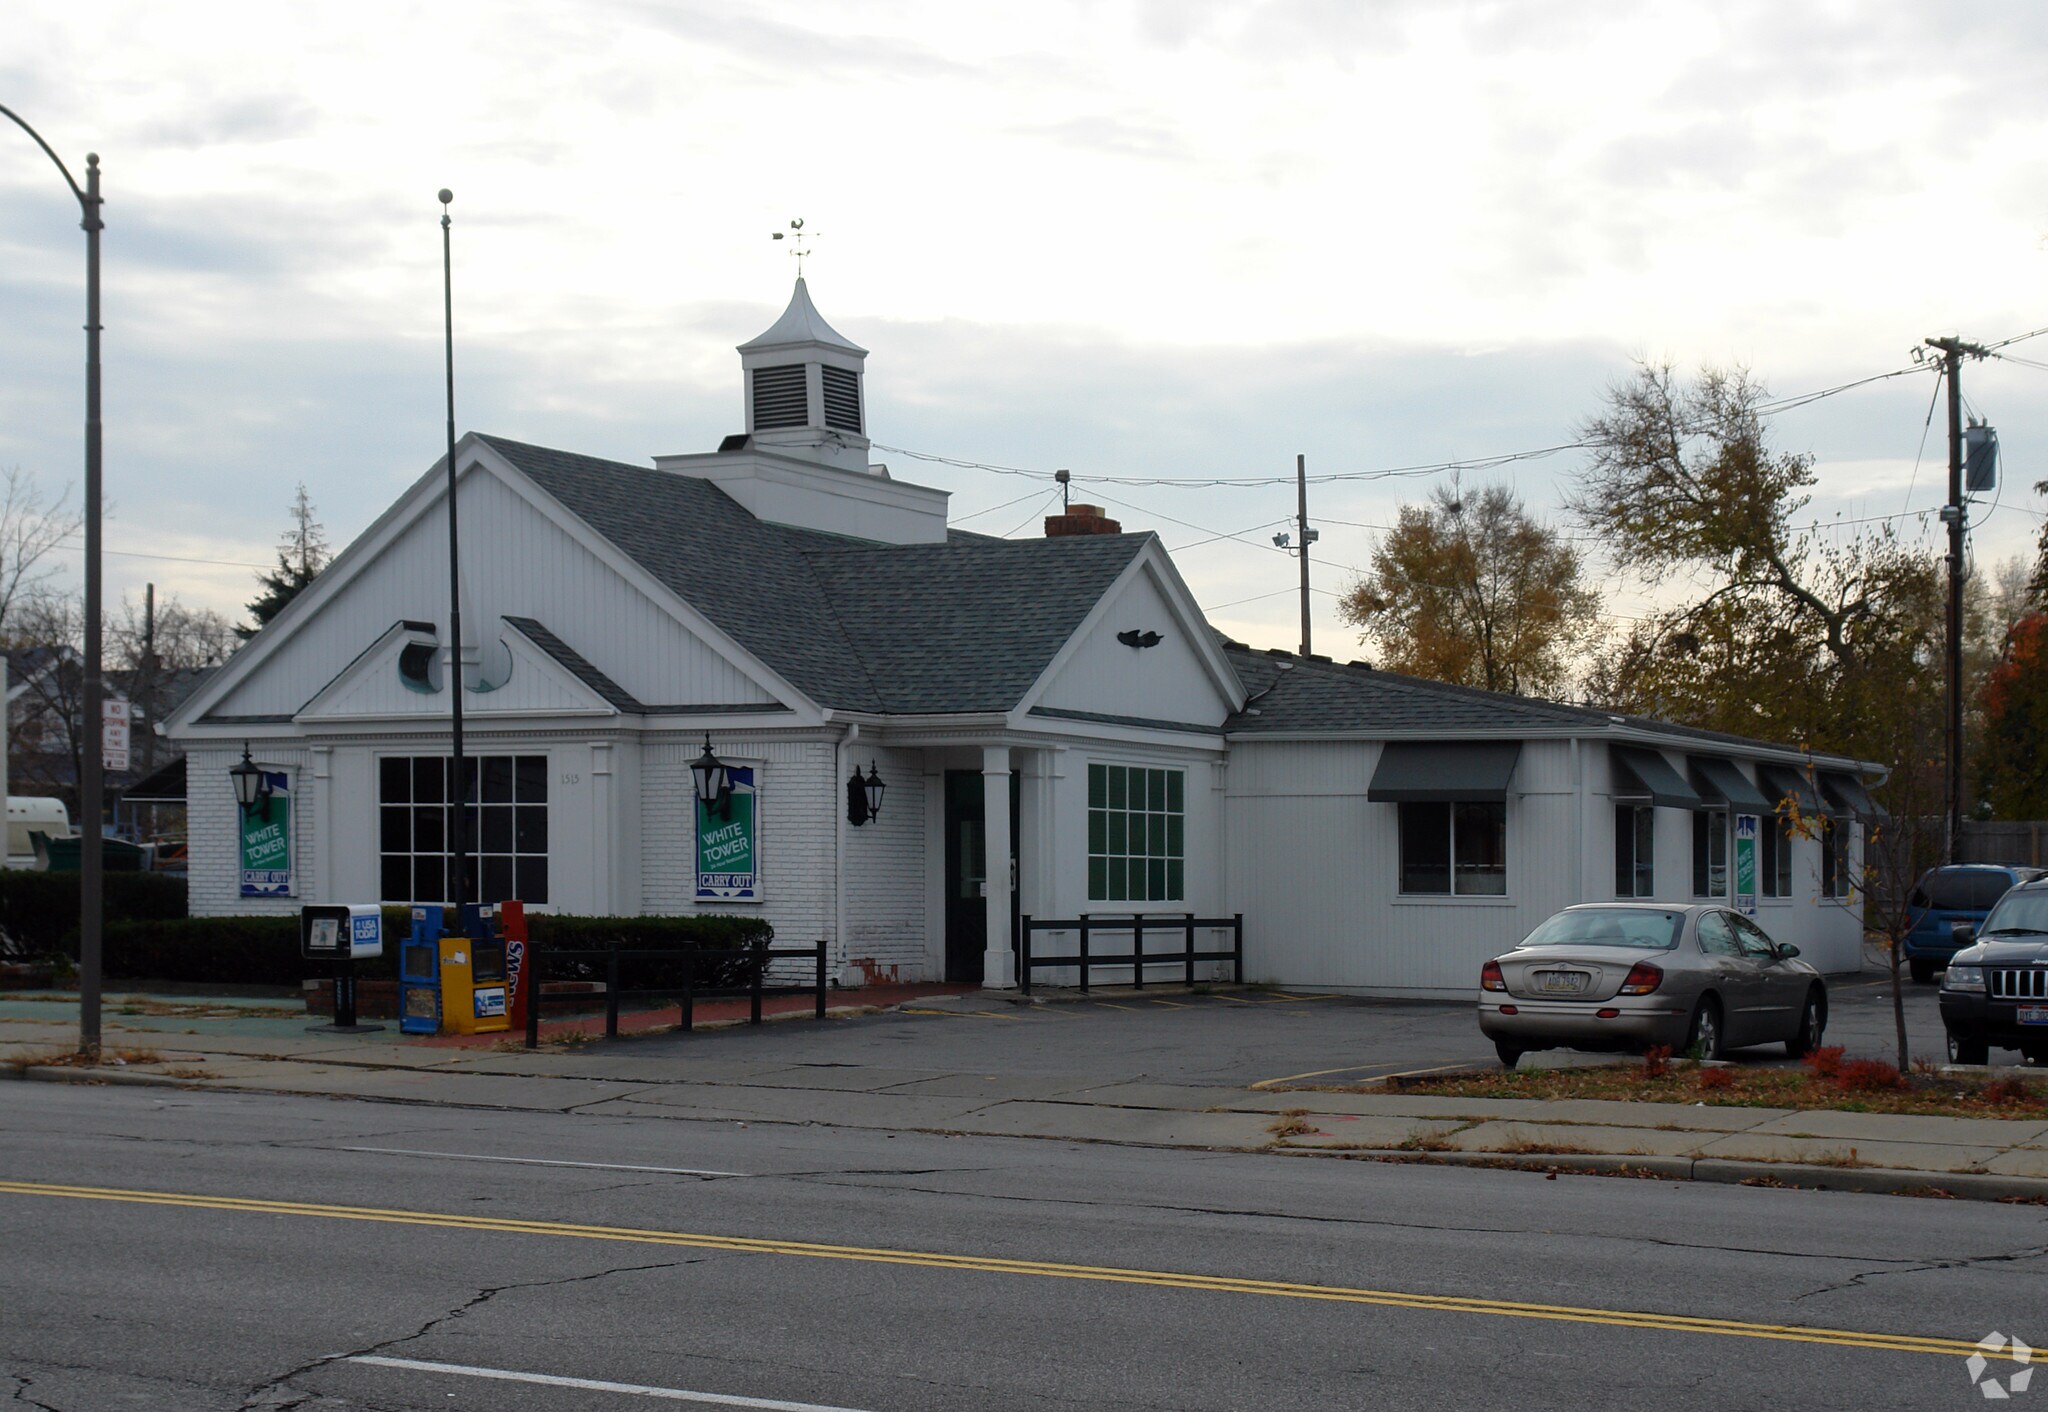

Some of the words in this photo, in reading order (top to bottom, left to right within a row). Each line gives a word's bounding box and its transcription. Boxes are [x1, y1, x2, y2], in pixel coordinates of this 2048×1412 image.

[245, 823, 281, 845] WHITE
[702, 822, 743, 846] WHITE
[246, 836, 286, 861] TOWER
[703, 836, 749, 862] TOWER
[245, 870, 270, 883] CARRY
[271, 870, 288, 883] OUT
[702, 875, 731, 888] CARRY
[732, 875, 752, 888] OUT
[361, 919, 376, 930] USA
[355, 928, 378, 940] TODAY
